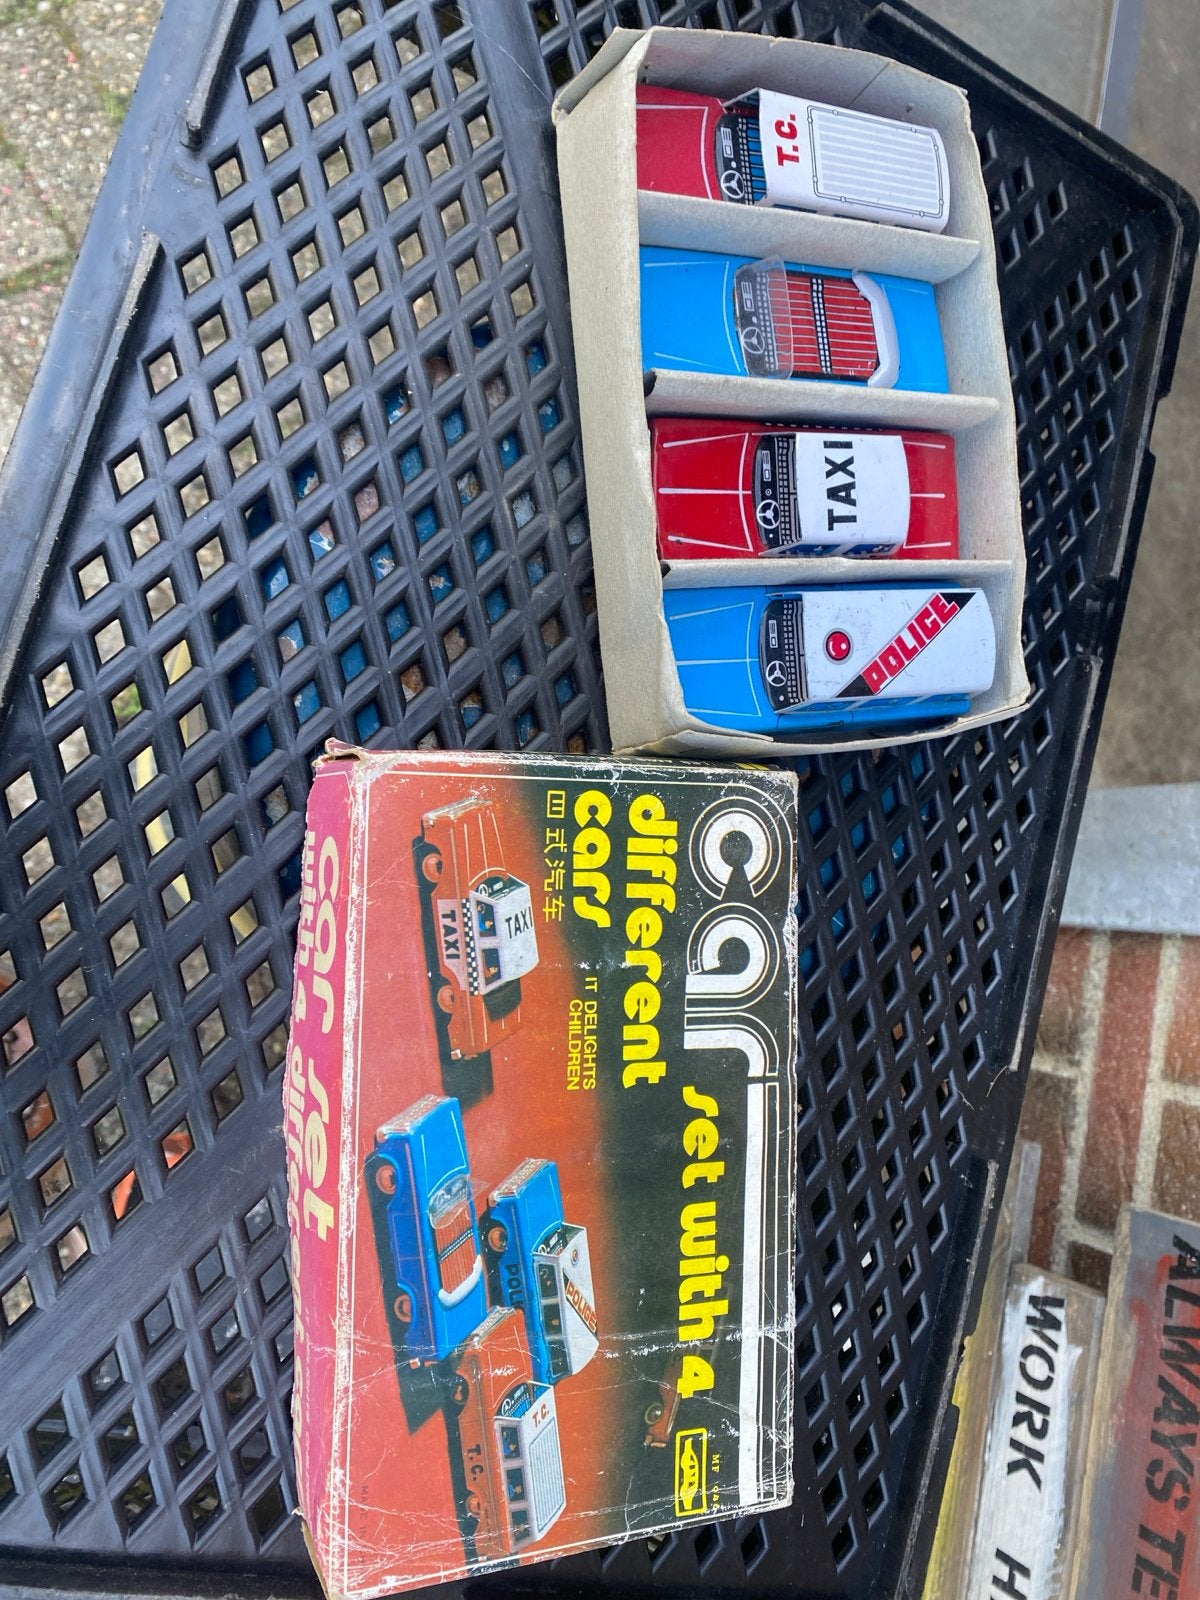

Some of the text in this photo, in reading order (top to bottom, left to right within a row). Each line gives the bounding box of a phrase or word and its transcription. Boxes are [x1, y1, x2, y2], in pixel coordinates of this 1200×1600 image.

[774, 113, 800, 167] T.C.
[823, 440, 858, 531] TAXI
[861, 592, 960, 695] POLICE
[543, 790, 567, 922] 四式汽车
[573, 790, 613, 928] cars
[441, 909, 460, 960] TAXI
[505, 907, 533, 939] TAXI
[622, 794, 678, 1089] different
[303, 836, 340, 1242] car set
[567, 999, 582, 1091] CHILDREN
[583, 977, 598, 1090] IT DELIGHTS
[677, 797, 783, 1399] car set with 4
[505, 1263, 523, 1306] POLI
[532, 1403, 550, 1428] T.C.
[1145, 1234, 1200, 1511] ALWAYS
[990, 1295, 1065, 1600] WORK H
